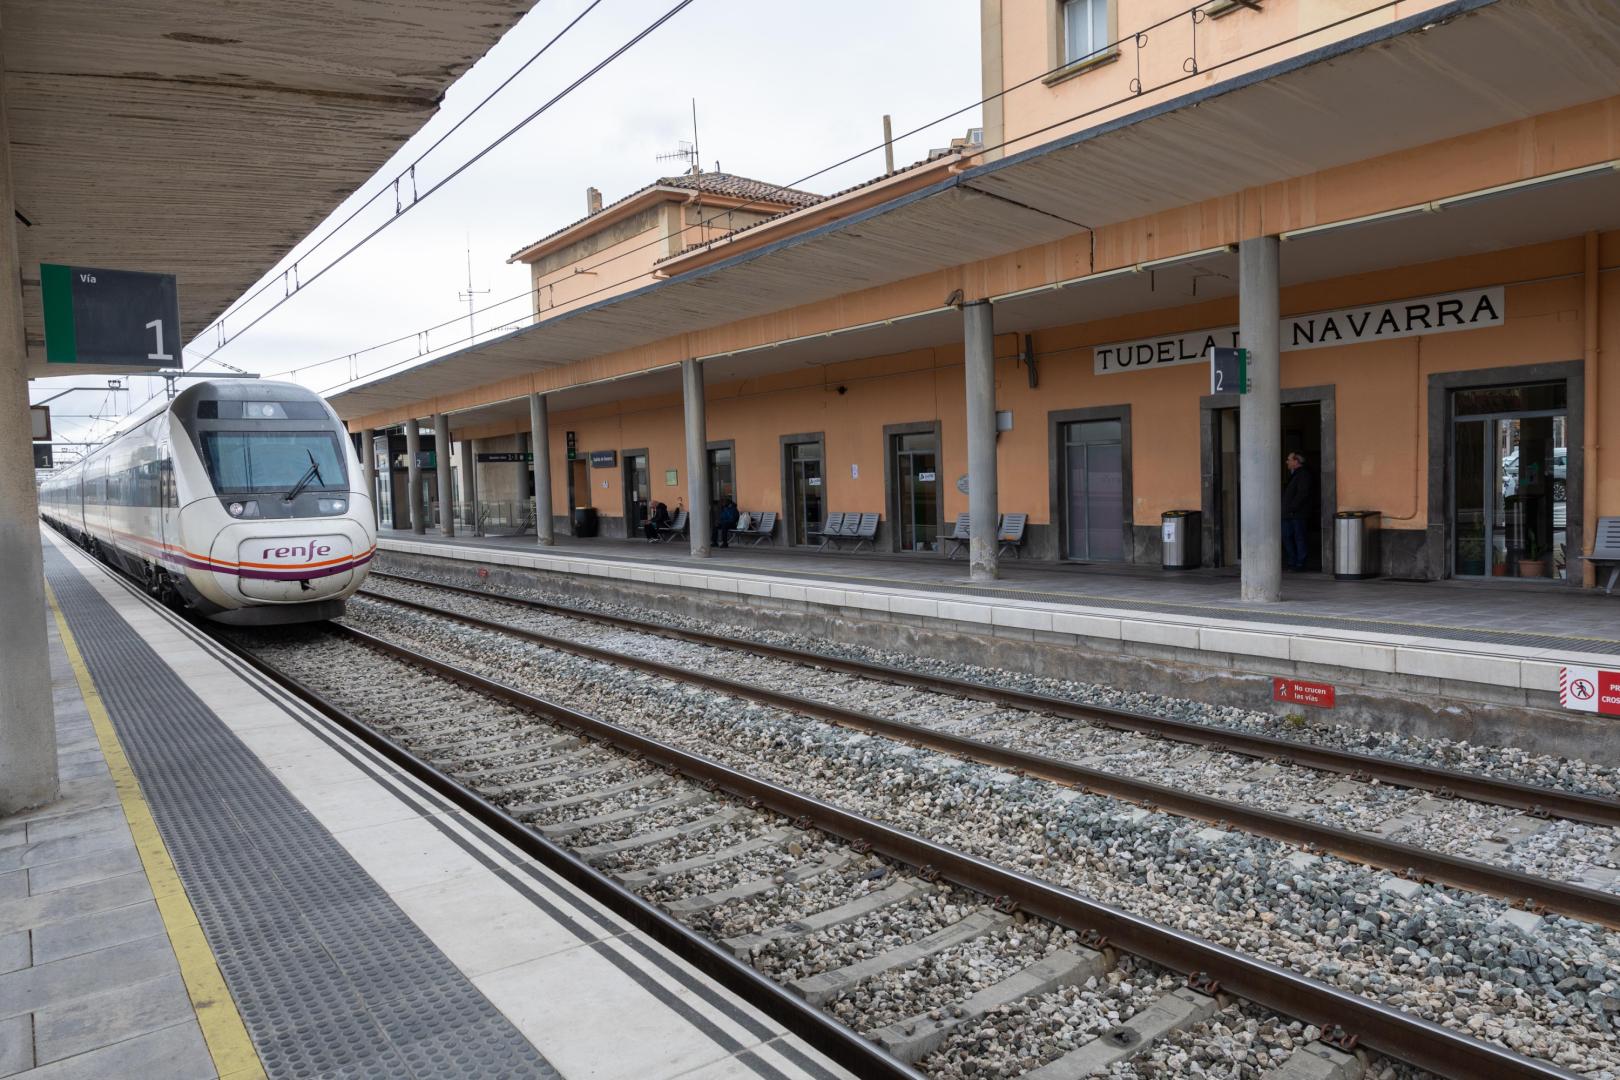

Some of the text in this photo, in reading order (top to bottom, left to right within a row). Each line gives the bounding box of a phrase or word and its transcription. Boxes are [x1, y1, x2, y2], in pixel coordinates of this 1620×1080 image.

[80, 273, 97, 284] Vía
[1292, 294, 1500, 346] NAVARRA
[145, 319, 173, 361] 1
[1097, 335, 1217, 370] TUDELA
[1216, 370, 1223, 391] 2
[42, 455, 51, 467] 1
[262, 540, 331, 562] renfe
[1294, 684, 1327, 695] No crucen
[1294, 692, 1319, 702] las vías
